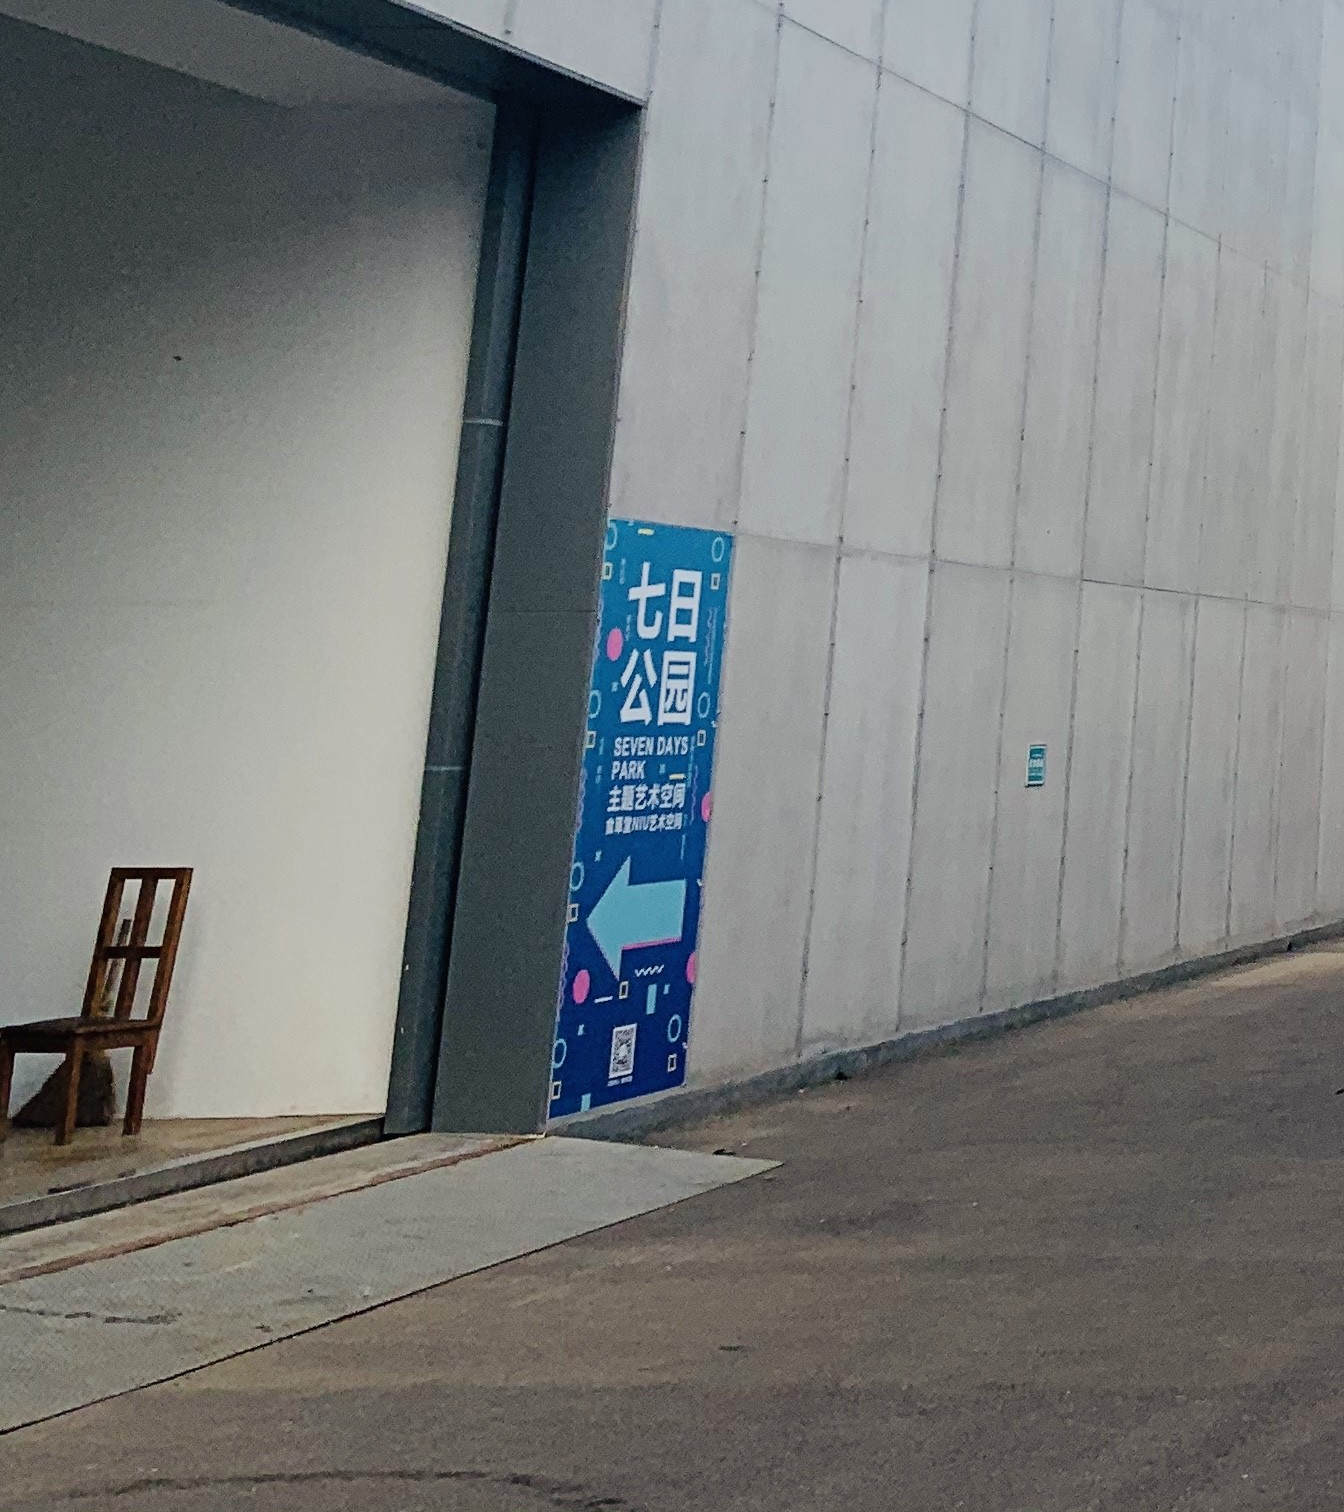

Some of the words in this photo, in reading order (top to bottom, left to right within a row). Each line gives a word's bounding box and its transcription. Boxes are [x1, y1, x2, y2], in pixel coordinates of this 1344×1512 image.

[627, 561, 703, 643] 七日
[619, 648, 697, 726] 公园
[613, 736, 655, 757] SEVEN
[656, 736, 688, 756] DAYS
[611, 760, 646, 780] PARK
[606, 783, 686, 812] 主题艺术空间
